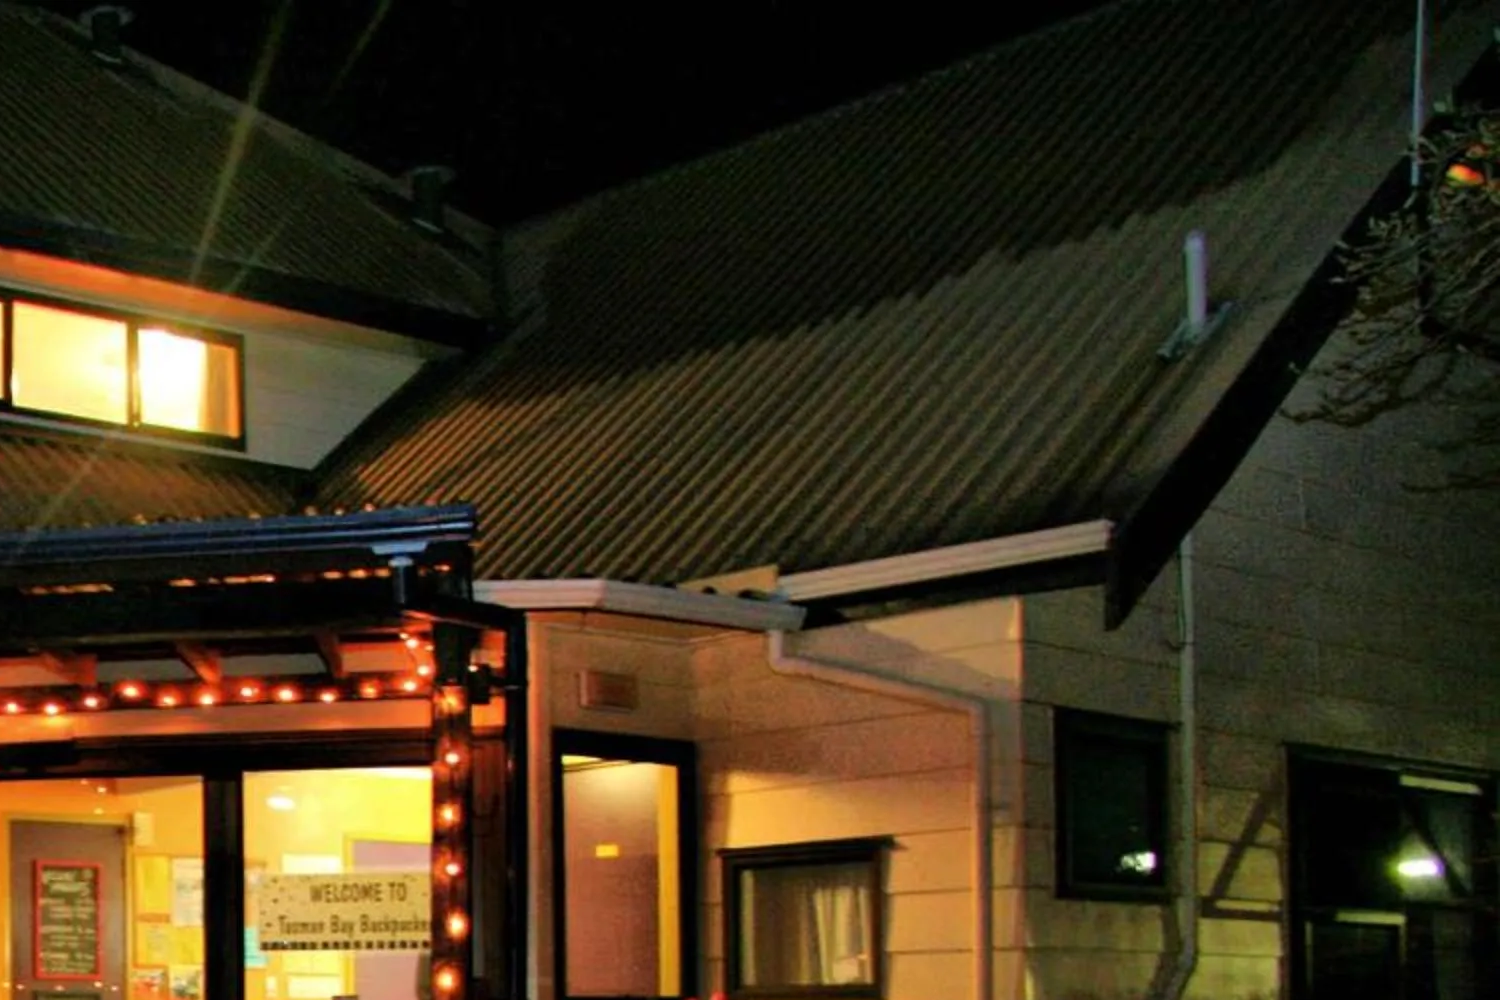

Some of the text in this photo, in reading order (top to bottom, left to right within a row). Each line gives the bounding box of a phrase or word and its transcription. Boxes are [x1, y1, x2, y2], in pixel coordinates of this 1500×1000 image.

[310, 882, 408, 903] WELCOME TO
[330, 914, 354, 938] Bay
